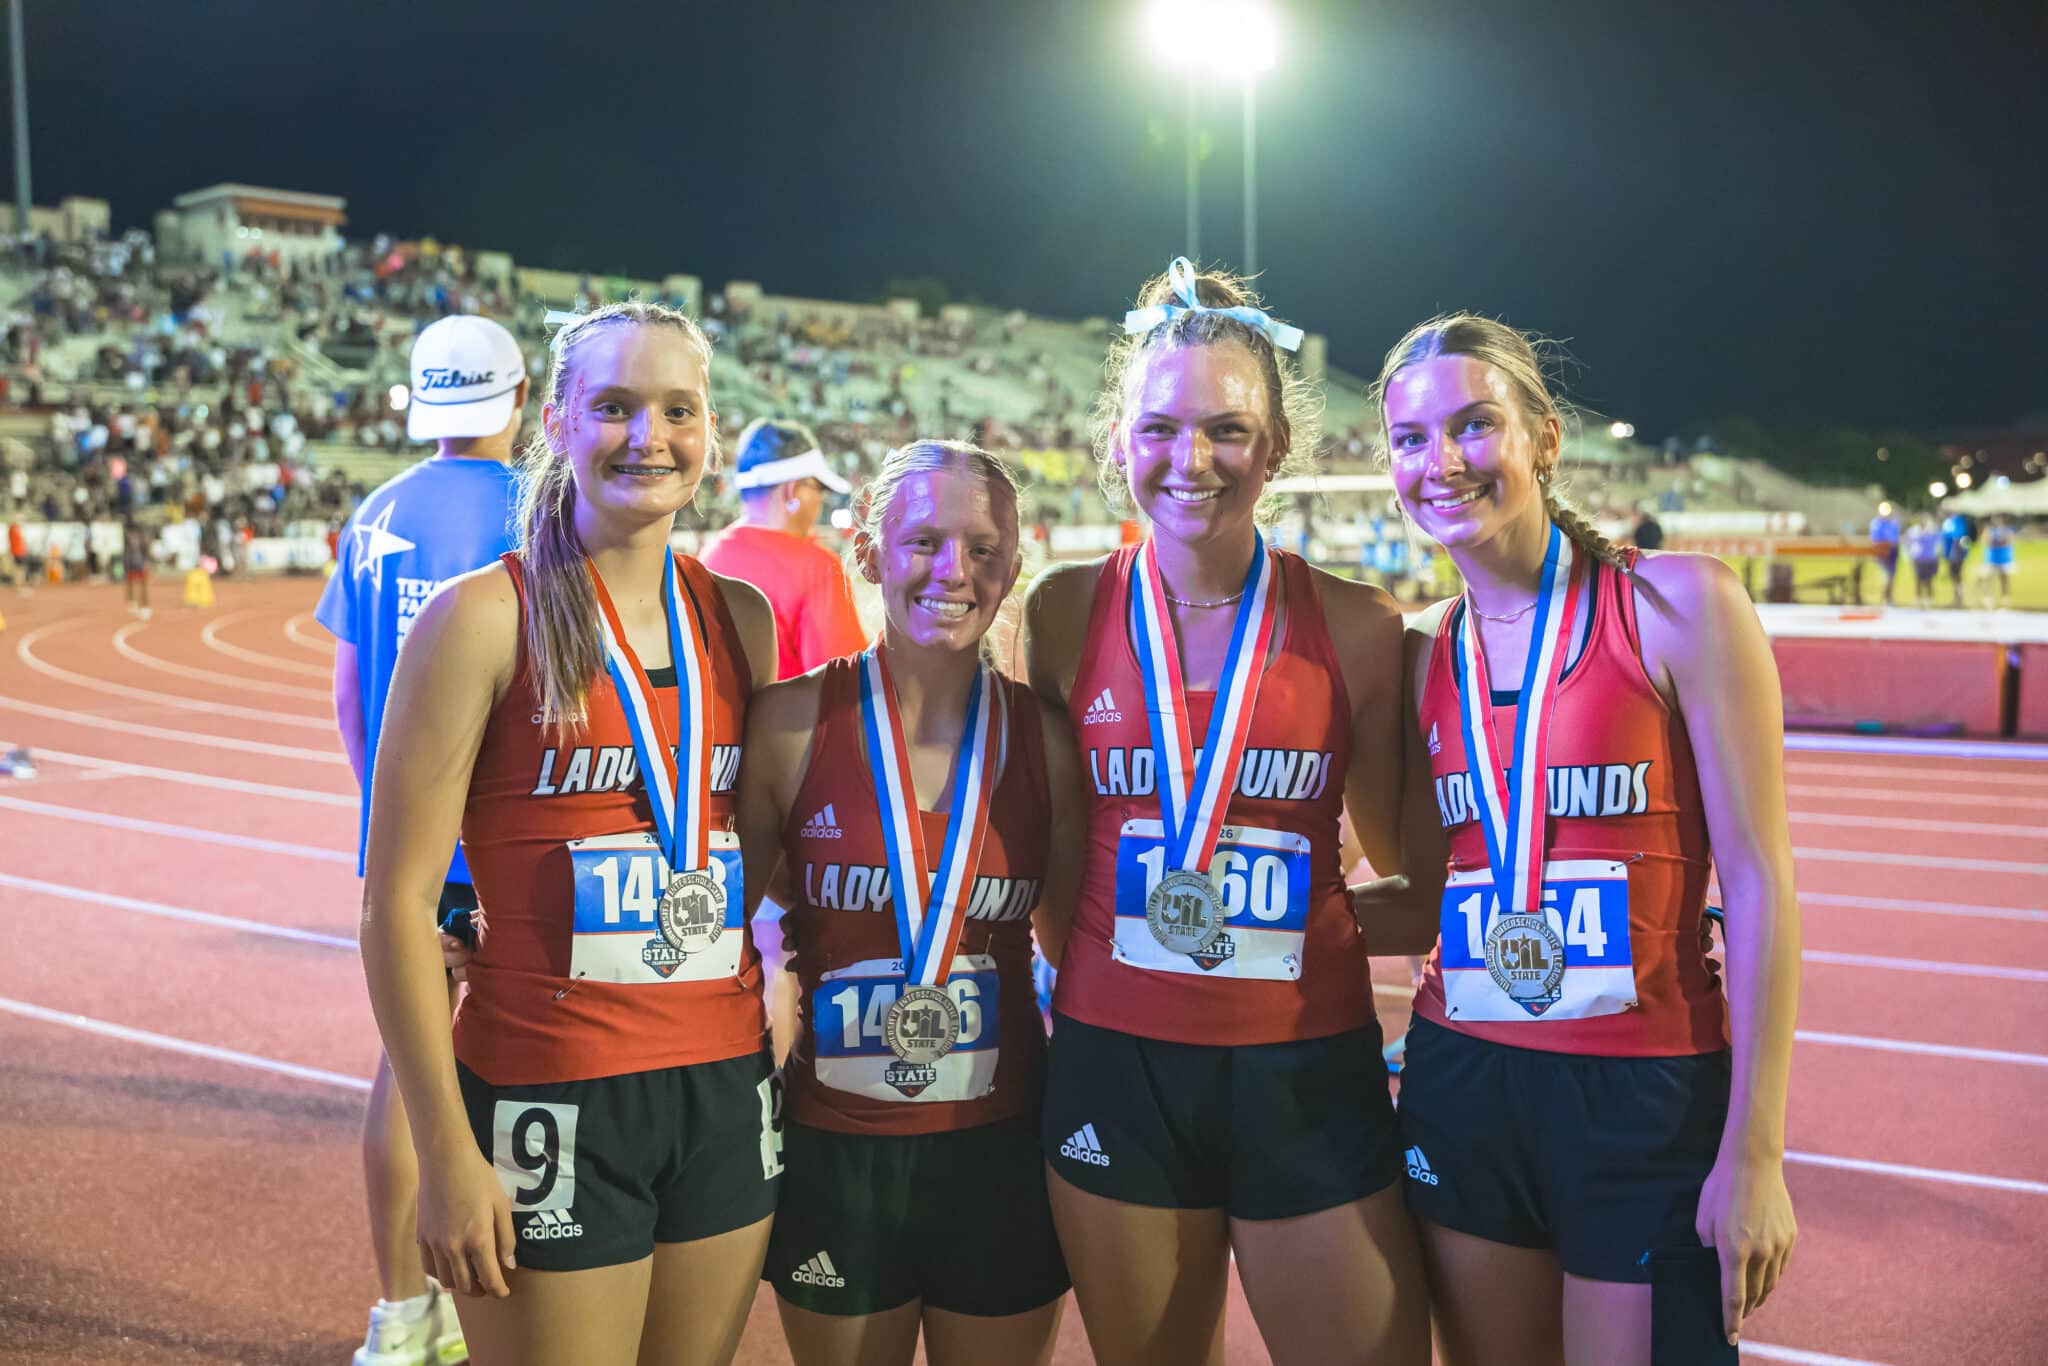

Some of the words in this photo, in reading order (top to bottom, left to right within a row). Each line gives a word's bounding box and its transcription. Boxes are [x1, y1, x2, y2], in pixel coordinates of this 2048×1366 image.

[421, 368, 495, 391] Titleist
[1084, 709, 1122, 725] adidas
[531, 746, 641, 796] LADY
[1090, 747, 1154, 797] LAD
[1194, 749, 1333, 799] UNDS
[800, 826, 843, 839] adidas
[1219, 828, 1233, 839] 26
[804, 862, 893, 913] LADY
[1137, 846, 1288, 921] 160
[681, 926, 708, 937] STATE
[643, 949, 687, 960] STATE
[1511, 971, 1541, 981] STATE
[831, 979, 982, 1048] 146
[906, 1039, 937, 1049] STATE
[886, 1069, 936, 1081] STATE
[512, 1107, 560, 1205] 9
[1060, 1144, 1110, 1167] adidas
[1408, 1165, 1439, 1186] das
[522, 1222, 583, 1240] adidas
[791, 1270, 845, 1288] adidas
